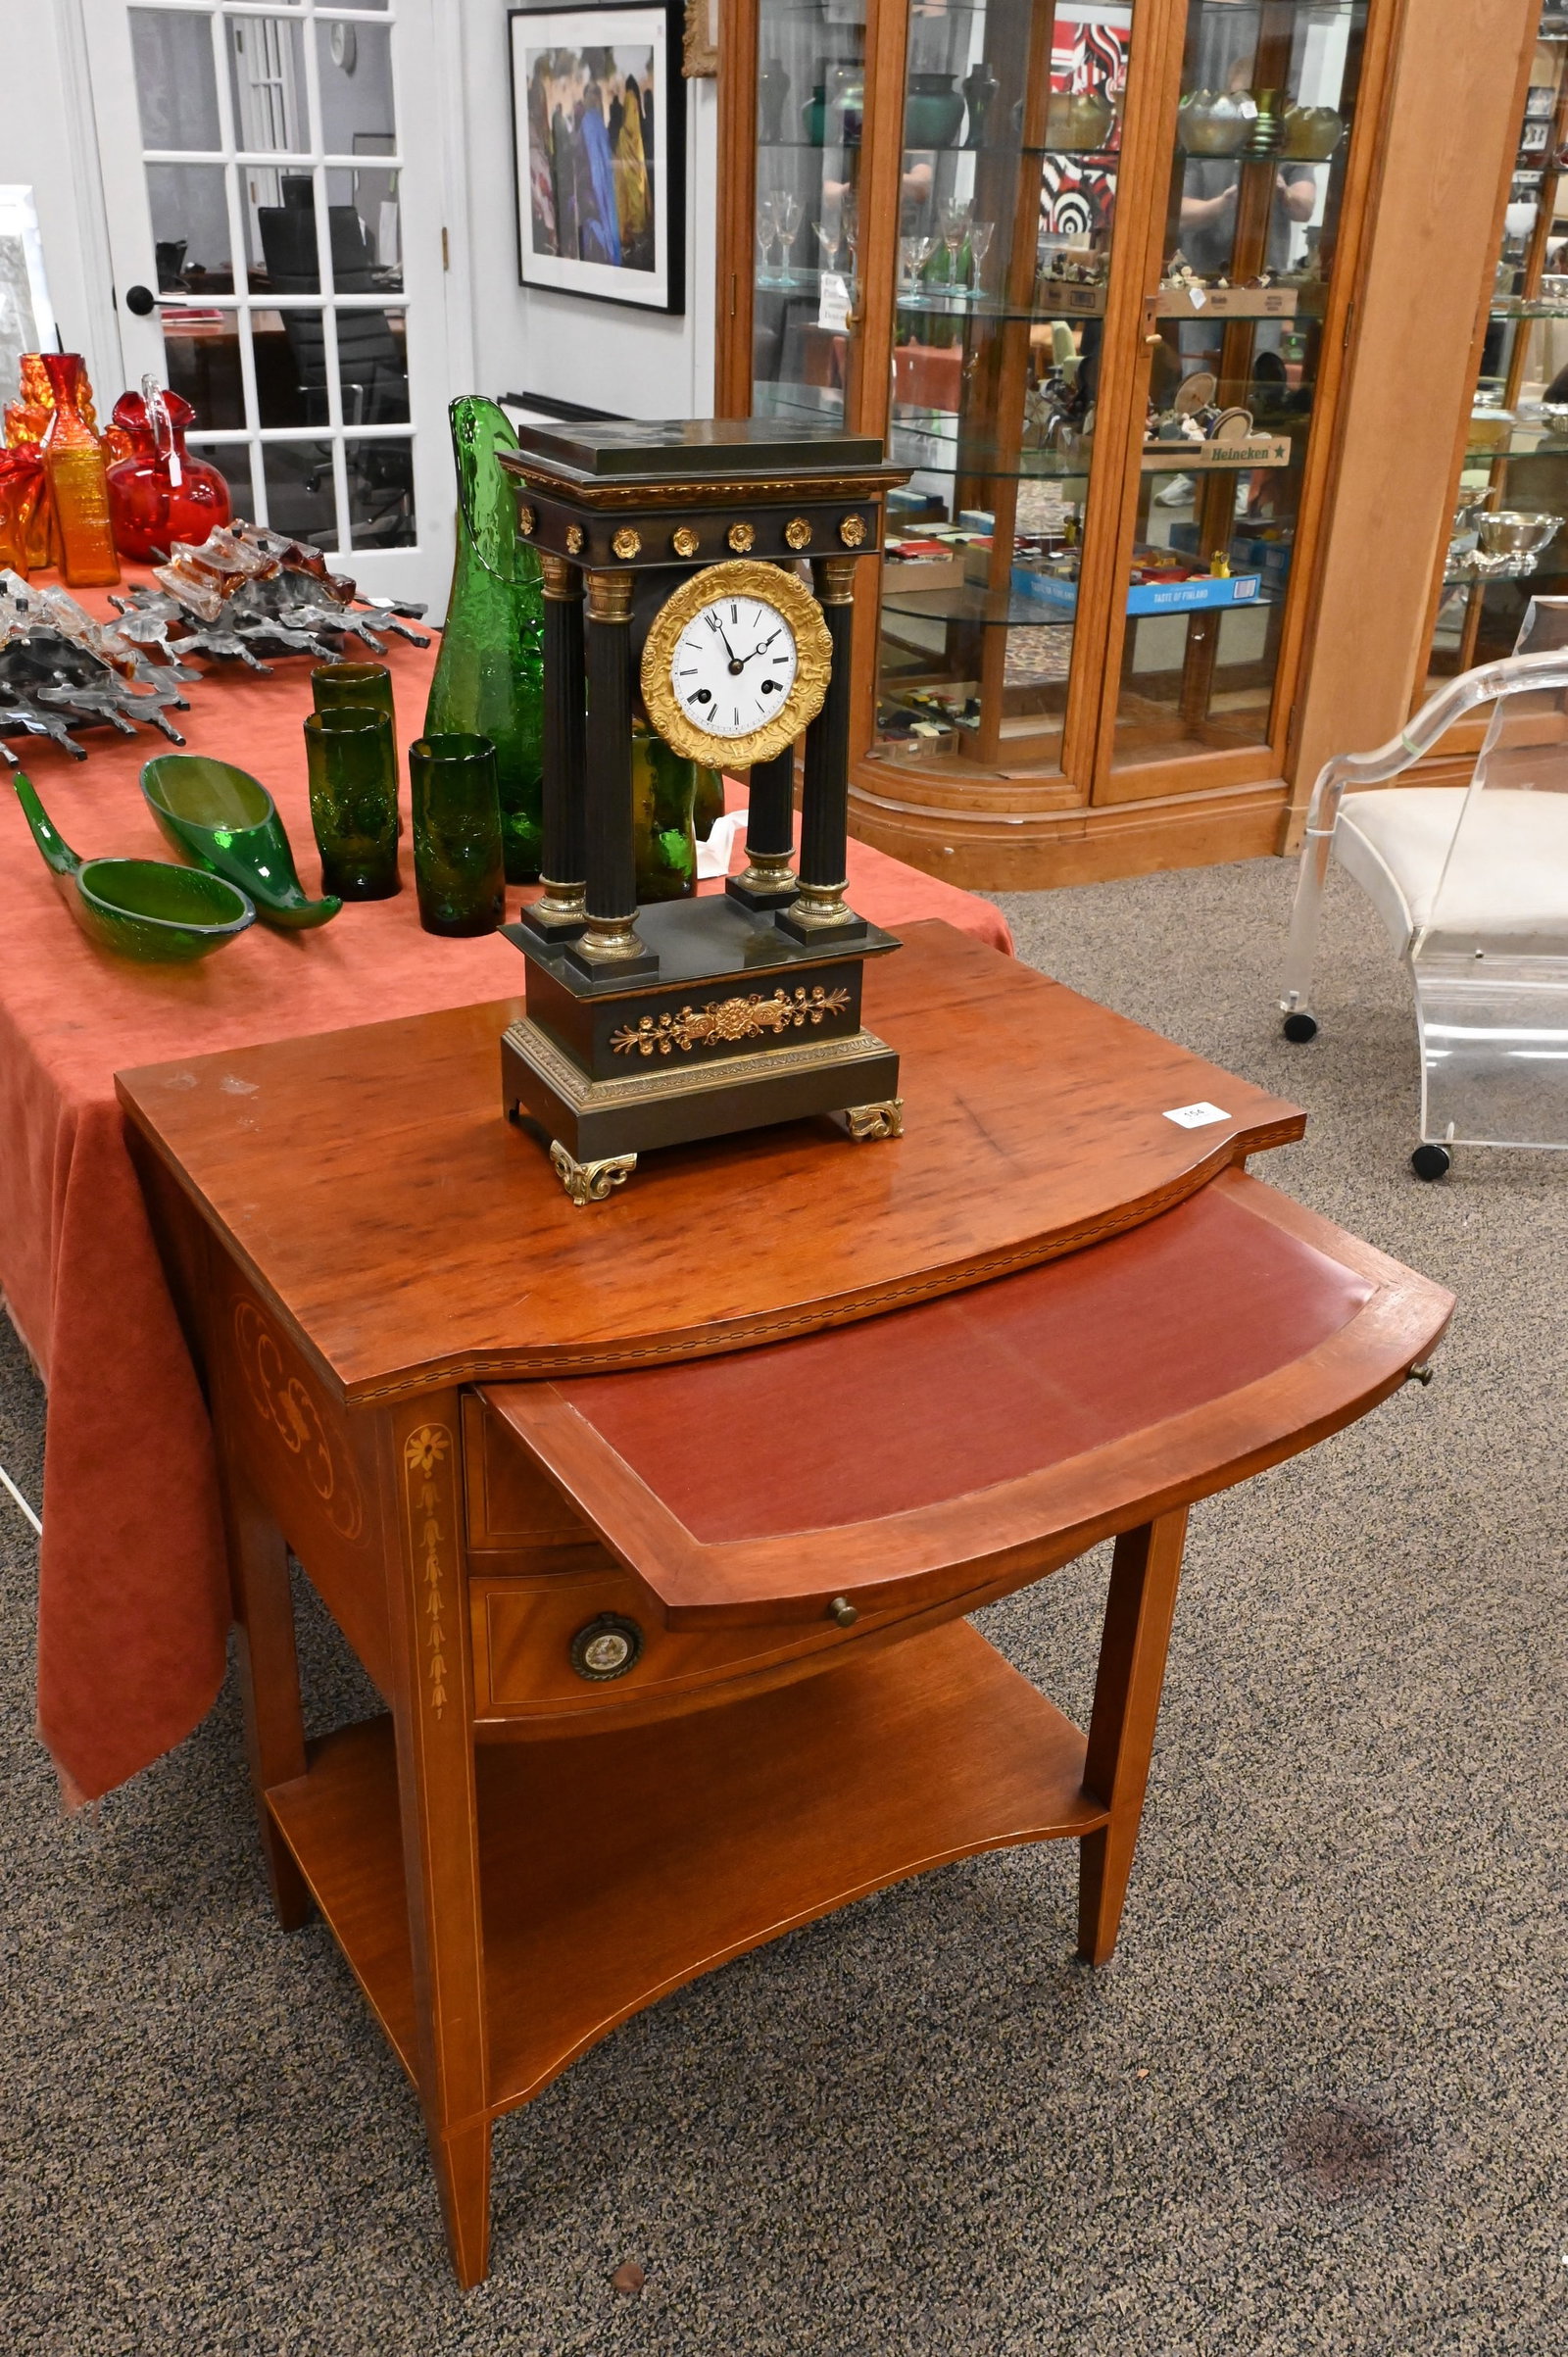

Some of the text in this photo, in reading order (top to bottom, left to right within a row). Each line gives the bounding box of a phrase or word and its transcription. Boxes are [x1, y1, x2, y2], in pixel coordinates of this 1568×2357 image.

[1211, 447, 1269, 461] Heineken
[1153, 589, 1208, 604] TASTE OF FINLAND
